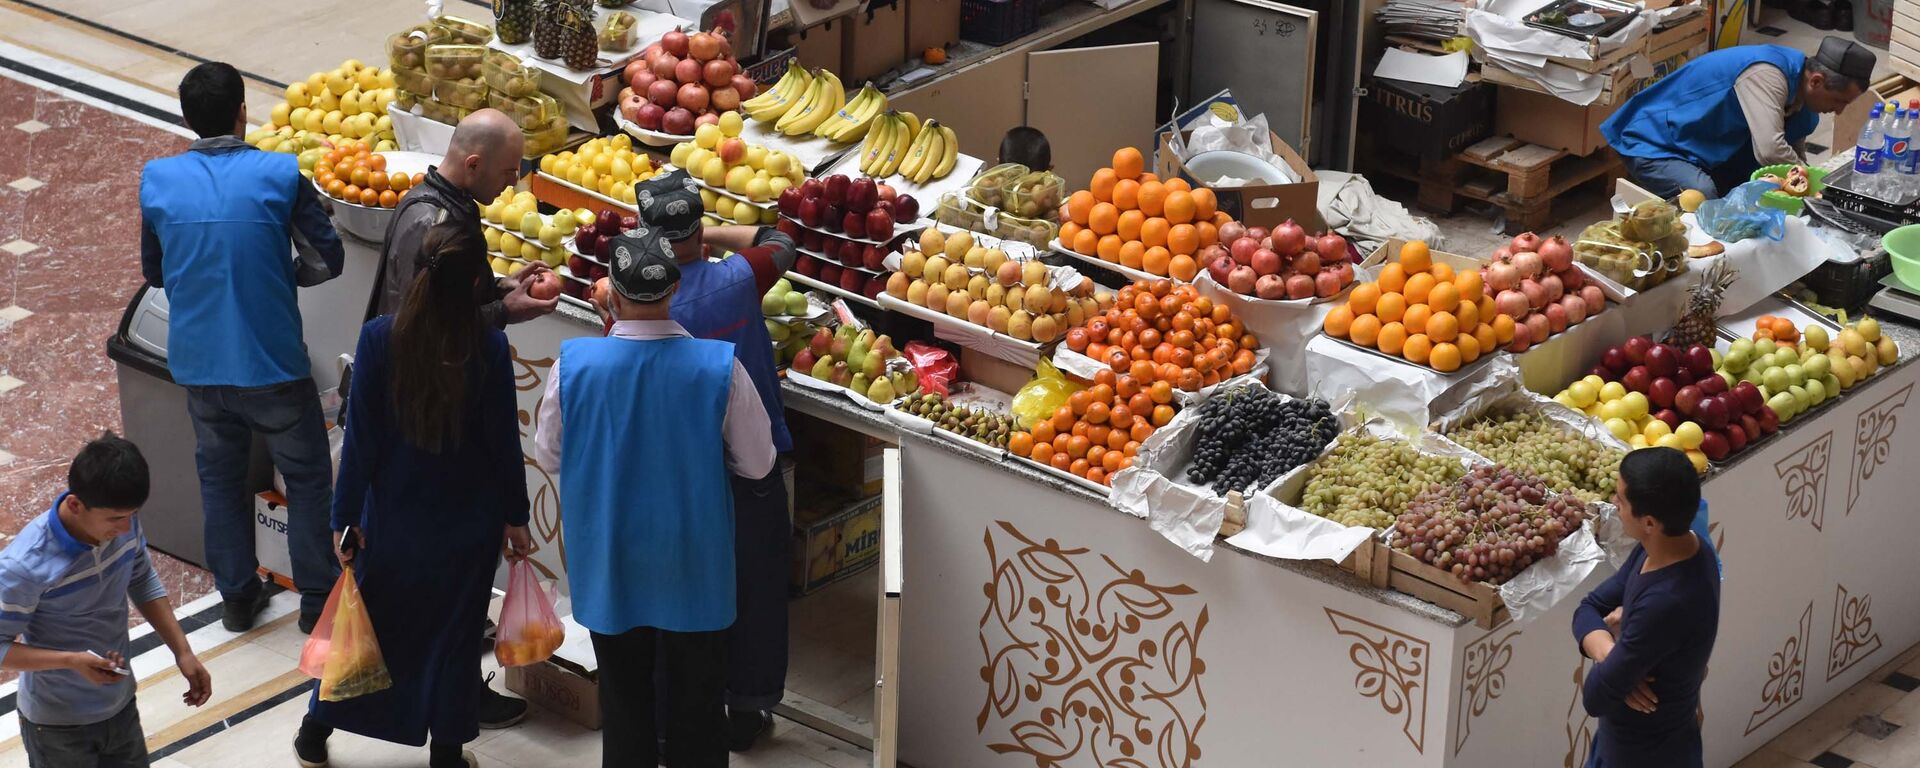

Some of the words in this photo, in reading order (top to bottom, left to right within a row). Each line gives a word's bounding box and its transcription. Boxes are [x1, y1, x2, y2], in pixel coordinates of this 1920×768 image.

[1375, 87, 1433, 122] ITRUS
[1858, 151, 1876, 162] RC
[845, 529, 880, 558] MİR
